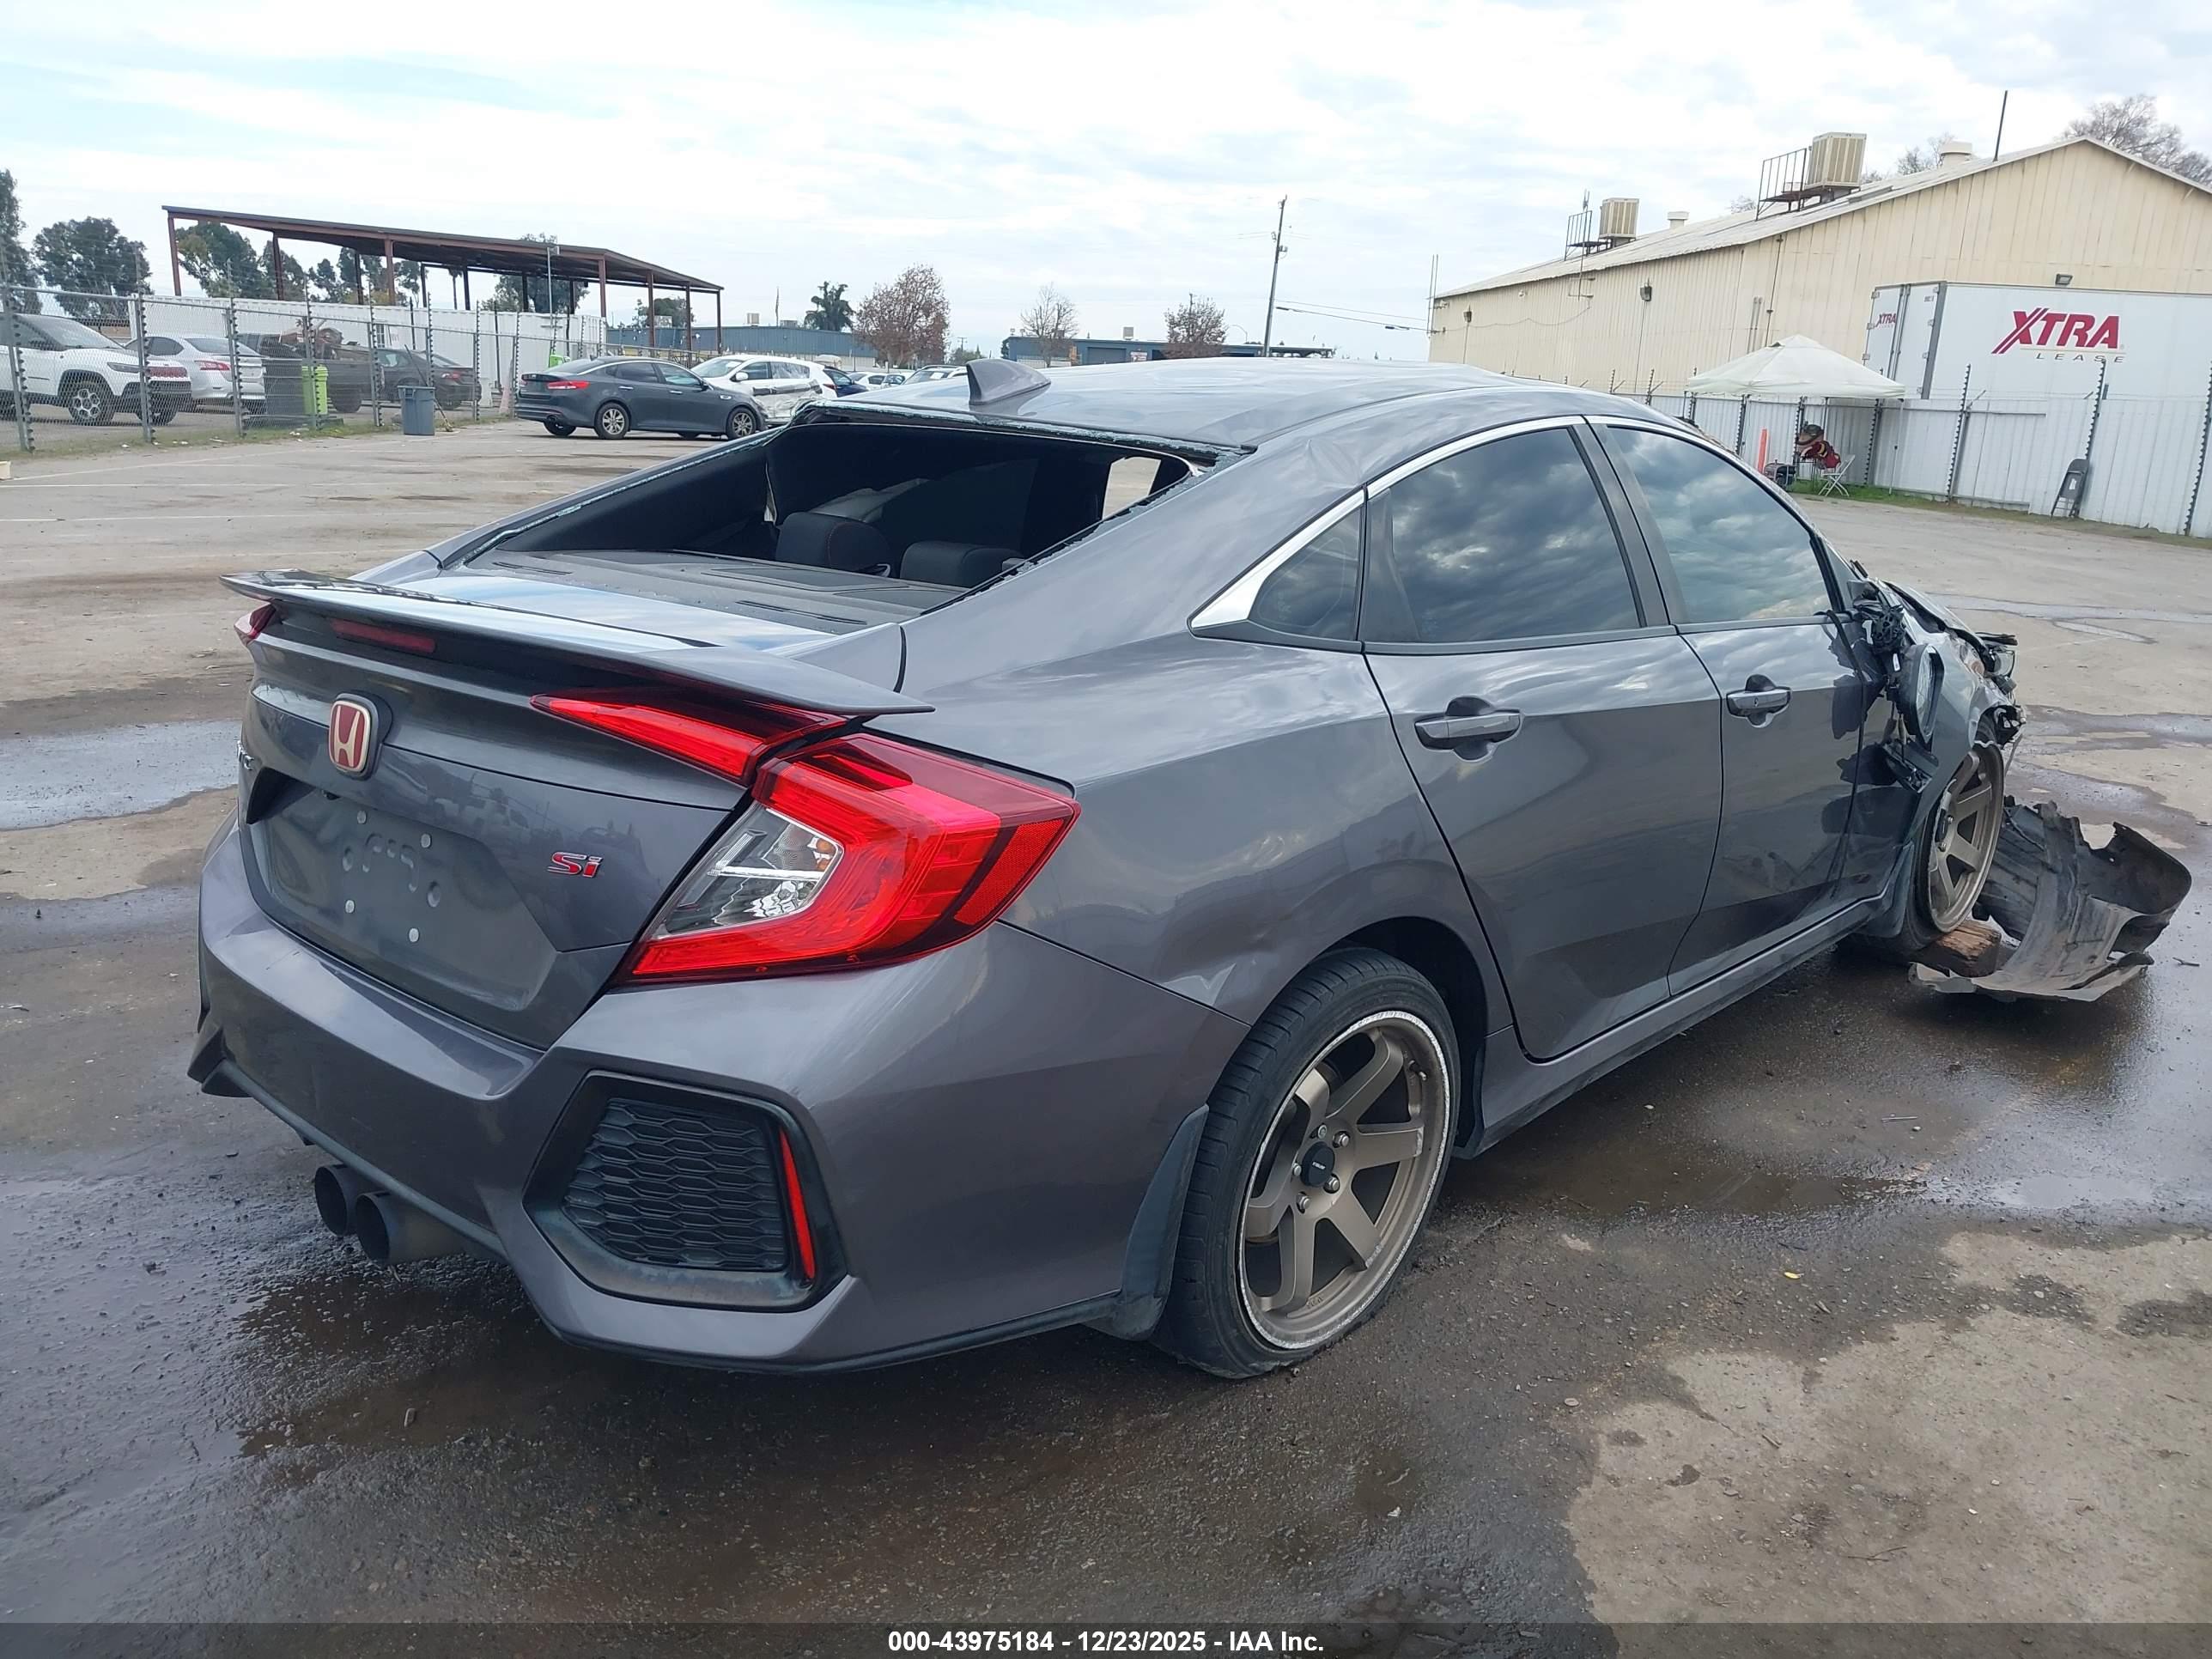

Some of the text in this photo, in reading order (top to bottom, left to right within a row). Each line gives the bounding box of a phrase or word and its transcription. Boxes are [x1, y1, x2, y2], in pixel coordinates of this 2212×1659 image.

[1875, 313, 1897, 327] XTRA
[1991, 307, 2119, 354] XTRA
[2036, 353, 2125, 363] LEASE
[547, 852, 603, 878] Si
